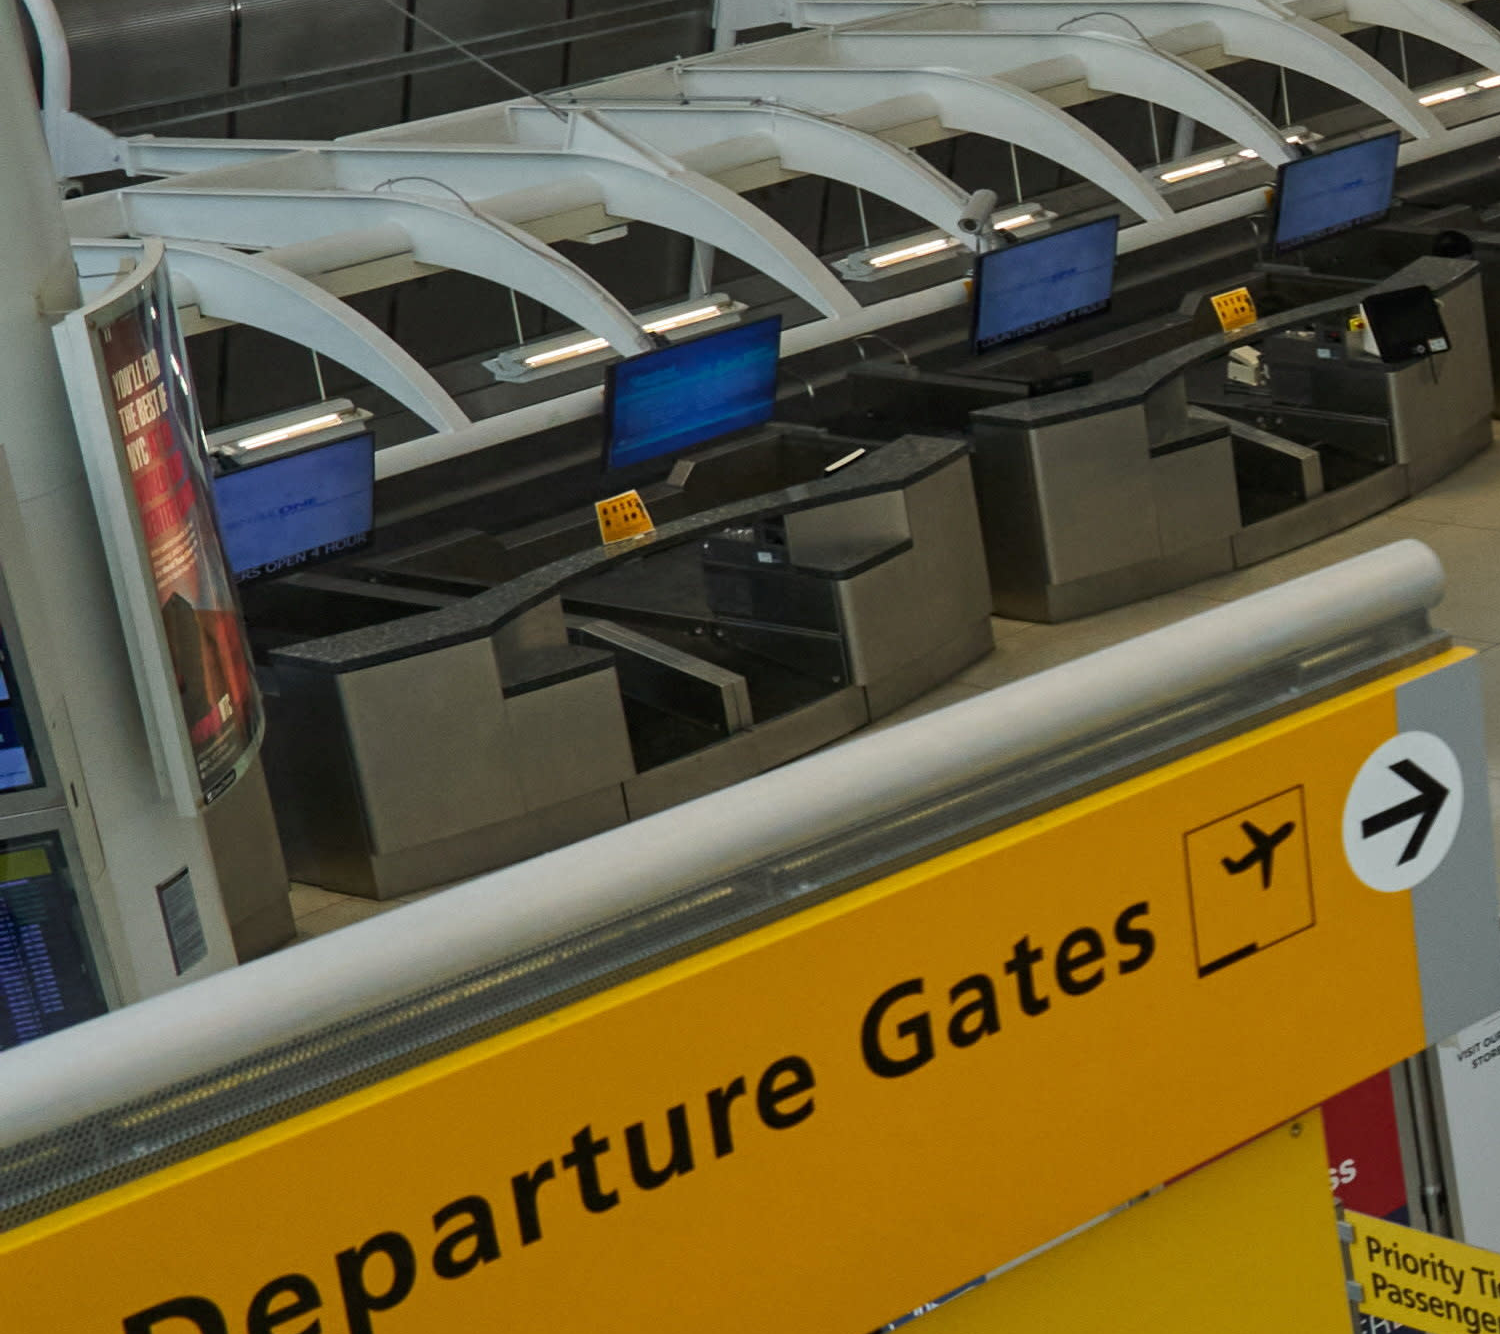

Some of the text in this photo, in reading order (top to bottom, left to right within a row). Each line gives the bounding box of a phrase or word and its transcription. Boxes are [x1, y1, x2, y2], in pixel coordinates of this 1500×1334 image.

[858, 896, 1159, 1084] Gates
[1456, 1042, 1481, 1062] VISIT
[1365, 1234, 1465, 1296] Priority
